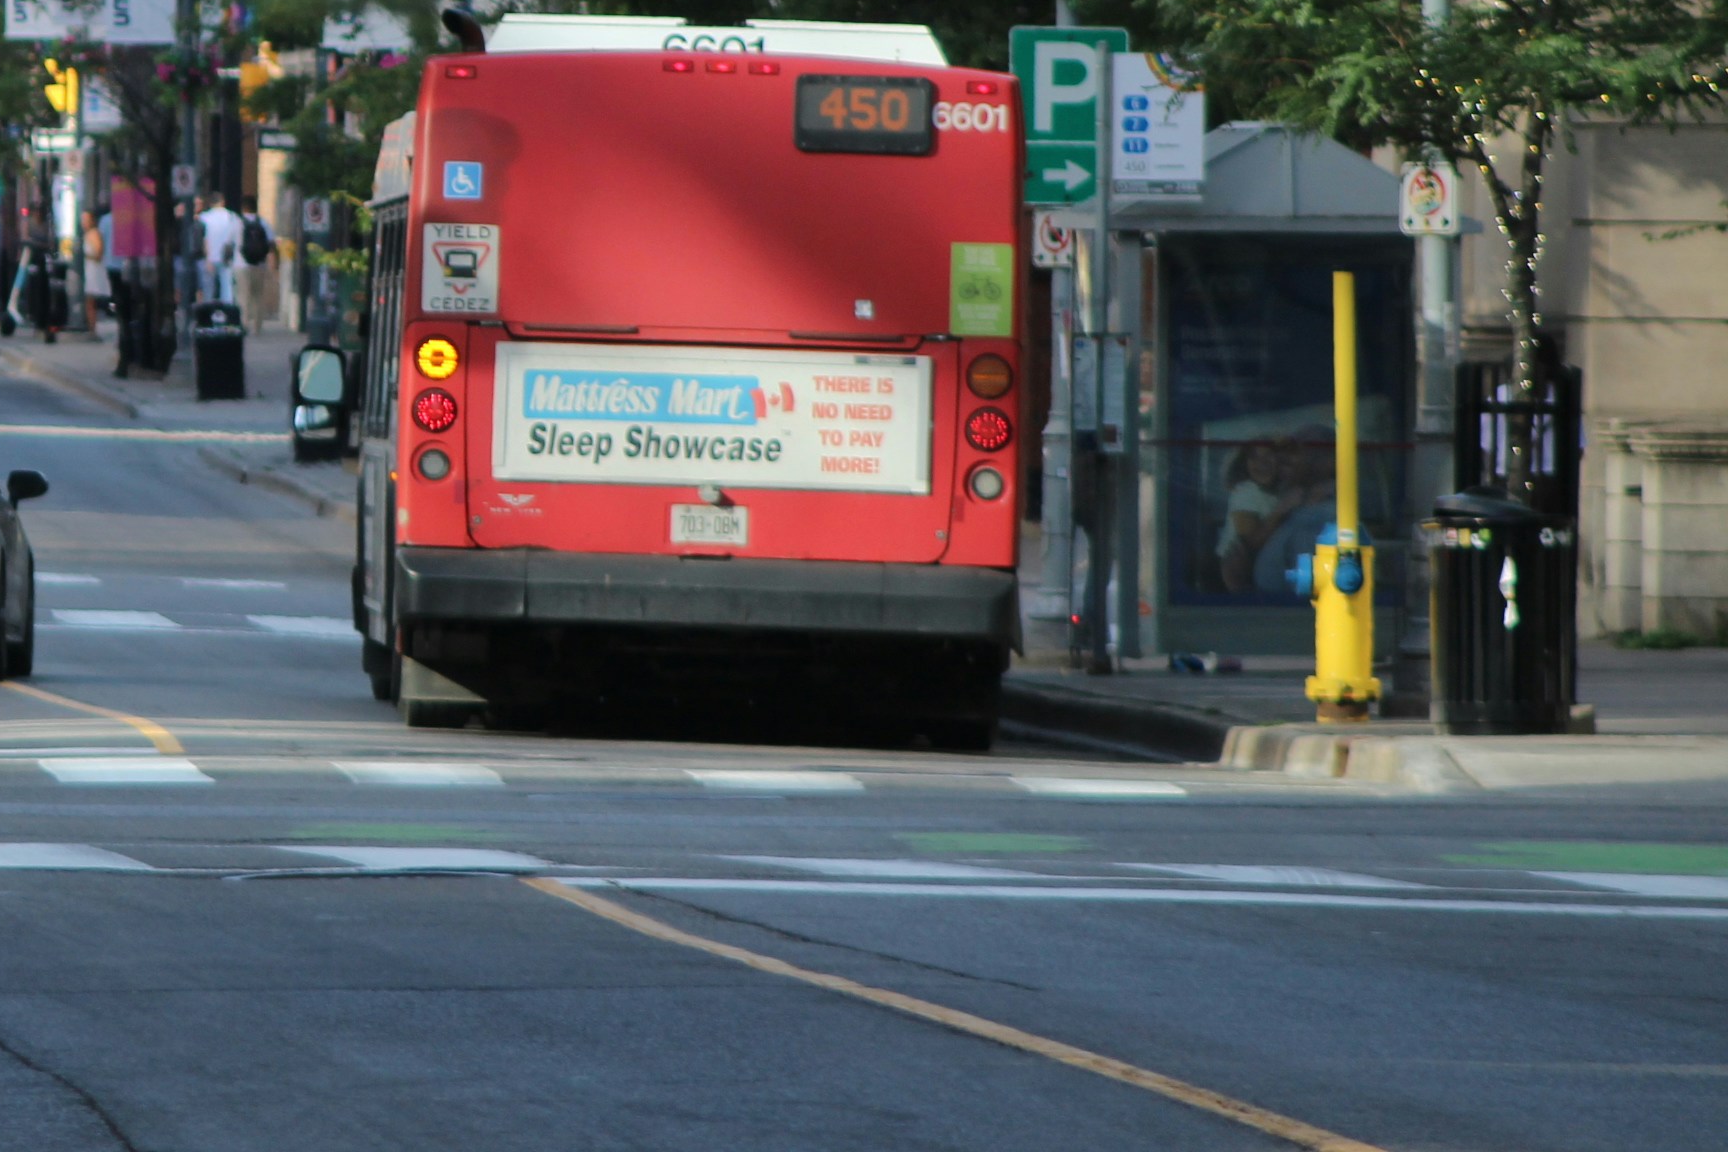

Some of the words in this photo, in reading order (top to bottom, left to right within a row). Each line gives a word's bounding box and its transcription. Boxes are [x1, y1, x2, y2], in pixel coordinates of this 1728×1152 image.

[1033, 40, 1099, 133] P
[819, 87, 910, 132] 450
[932, 101, 1010, 133] 6601
[433, 224, 491, 239] YIELD
[812, 375, 871, 393] THERE
[876, 377, 895, 394] IS
[667, 378, 750, 420] Mart
[812, 401, 838, 419] NO
[844, 403, 893, 420] NEED
[526, 421, 613, 465] Sleep
[624, 424, 783, 462] Showcase
[818, 429, 844, 447] TO
[849, 430, 884, 447] PAY
[820, 455, 880, 473] MORE!
